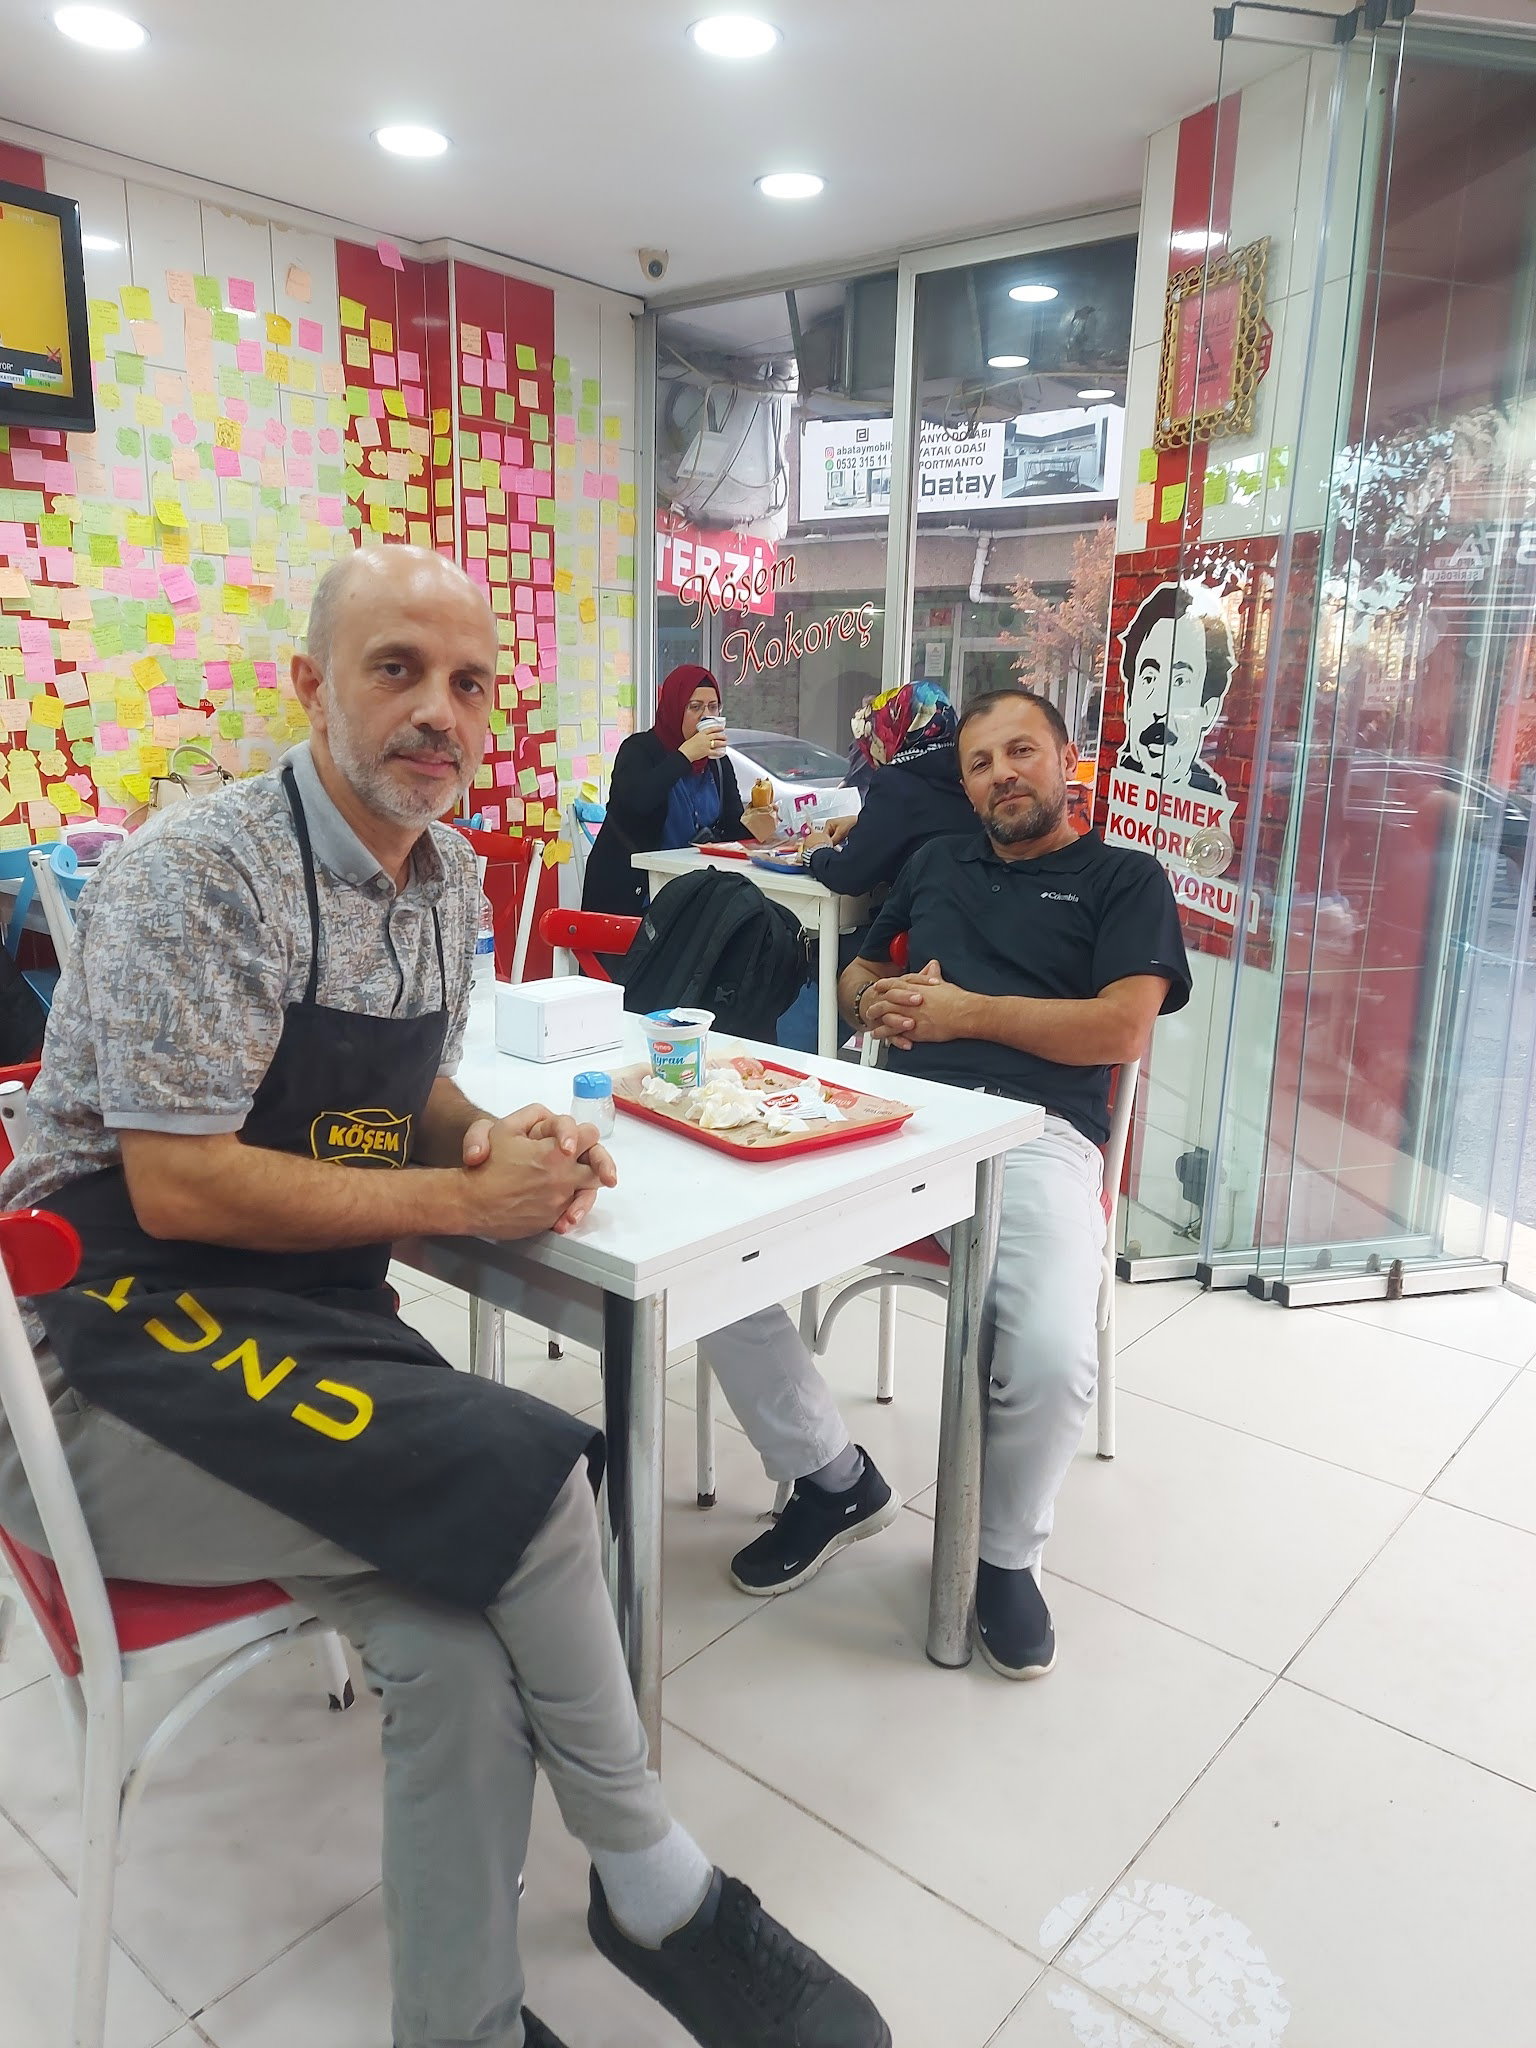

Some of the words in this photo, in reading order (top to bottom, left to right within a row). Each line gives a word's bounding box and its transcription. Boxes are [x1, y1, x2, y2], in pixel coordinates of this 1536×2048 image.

[836, 458, 856, 470] 0532
[860, 456, 874, 467] 315
[954, 442, 986, 454] ODASI
[678, 554, 797, 630] Köşem
[721, 601, 875, 686] Kokoreç
[1113, 779, 1139, 807] NE
[1145, 789, 1225, 828] DEMEK
[328, 1123, 400, 1155] KÖŞEM
